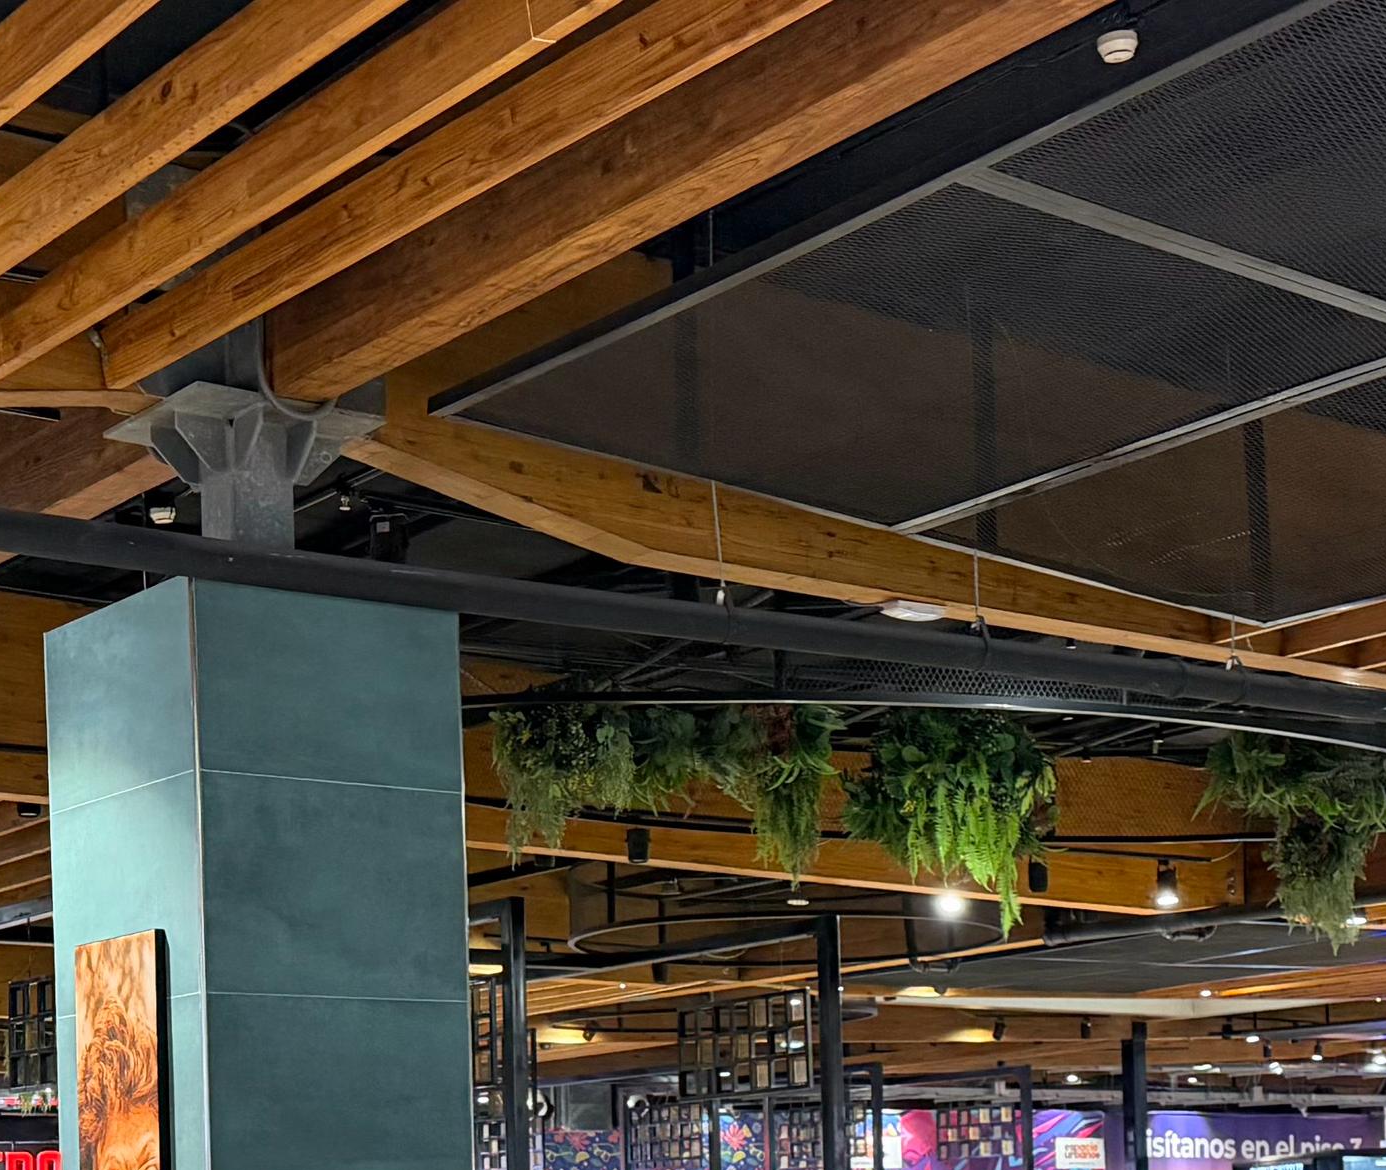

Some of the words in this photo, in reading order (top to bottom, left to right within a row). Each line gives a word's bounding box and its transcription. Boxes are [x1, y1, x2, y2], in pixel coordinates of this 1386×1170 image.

[1146, 1129, 1236, 1160] isítanos
[1241, 1139, 1269, 1160] en
[1275, 1134, 1294, 1158] el
